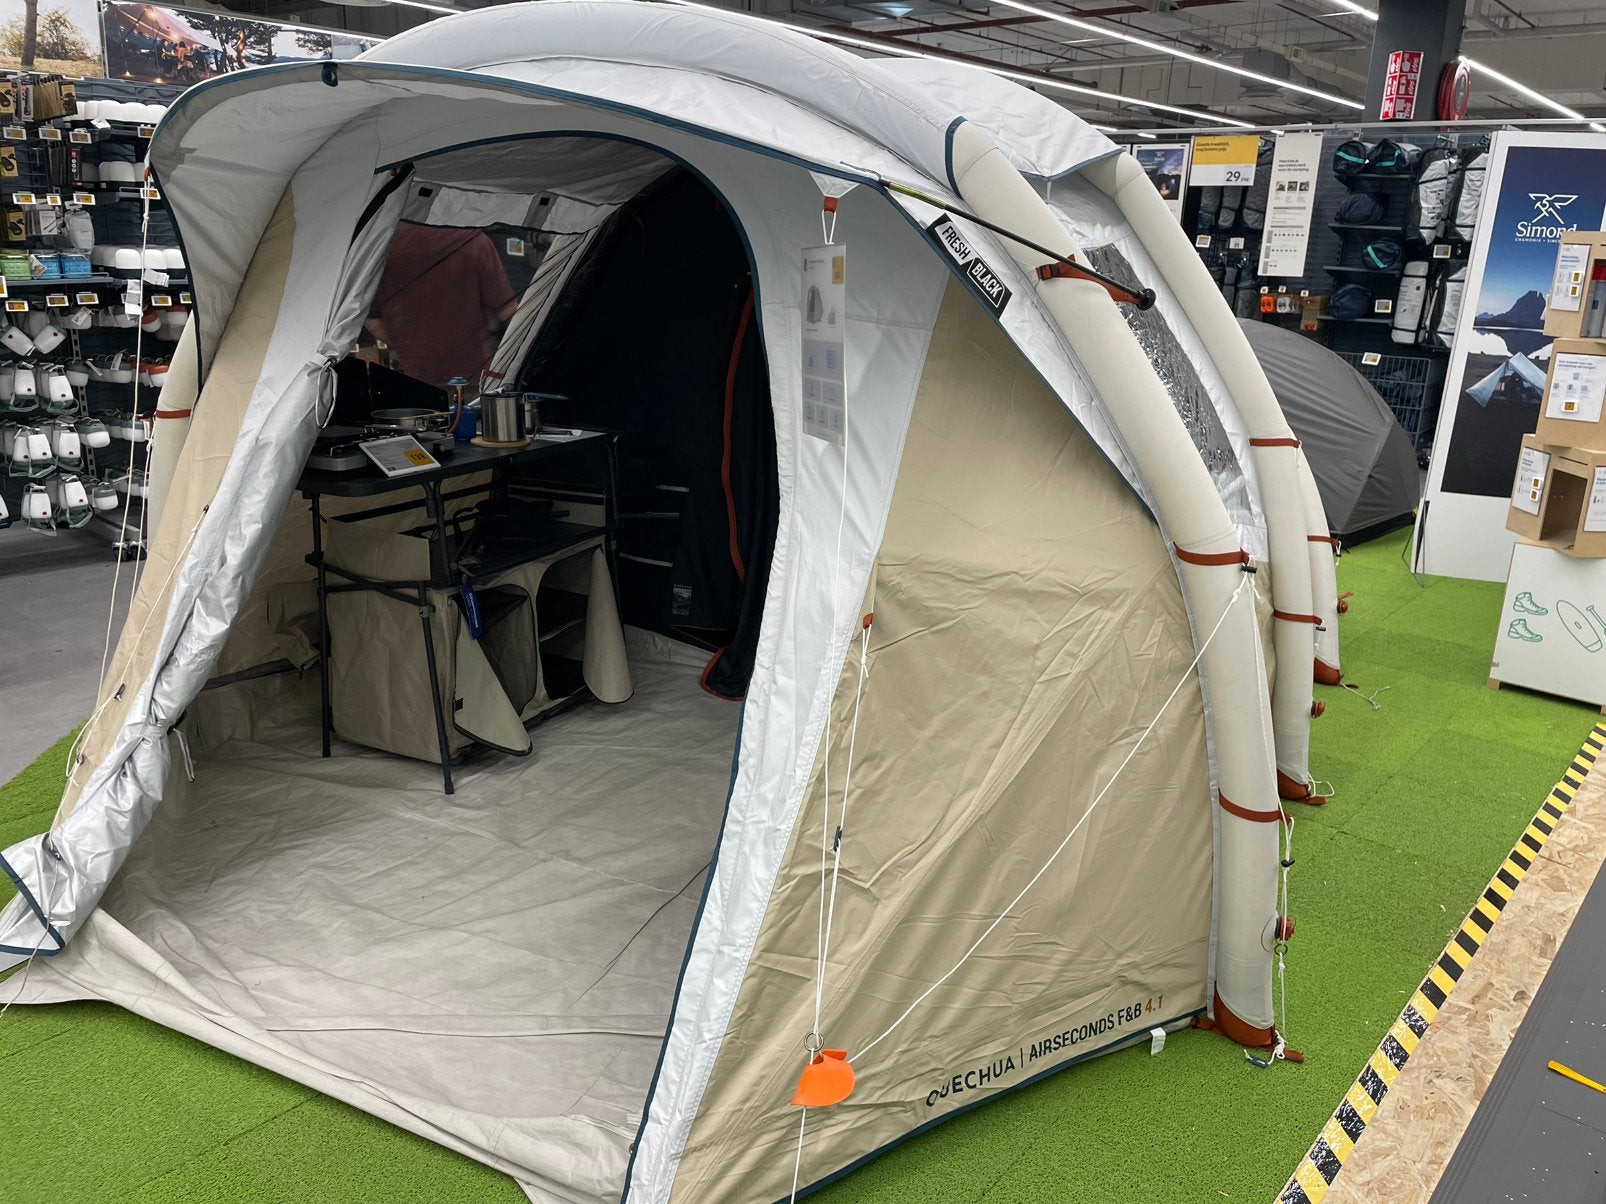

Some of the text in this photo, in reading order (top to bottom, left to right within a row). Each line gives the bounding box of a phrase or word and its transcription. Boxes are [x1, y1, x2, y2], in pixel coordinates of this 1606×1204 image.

[1226, 171, 1241, 182] 29
[941, 225, 971, 260] FRESH
[971, 262, 1003, 298] BLACK
[925, 995, 1164, 1107] QUECHUA AIRSECONDS F&B 4.1
